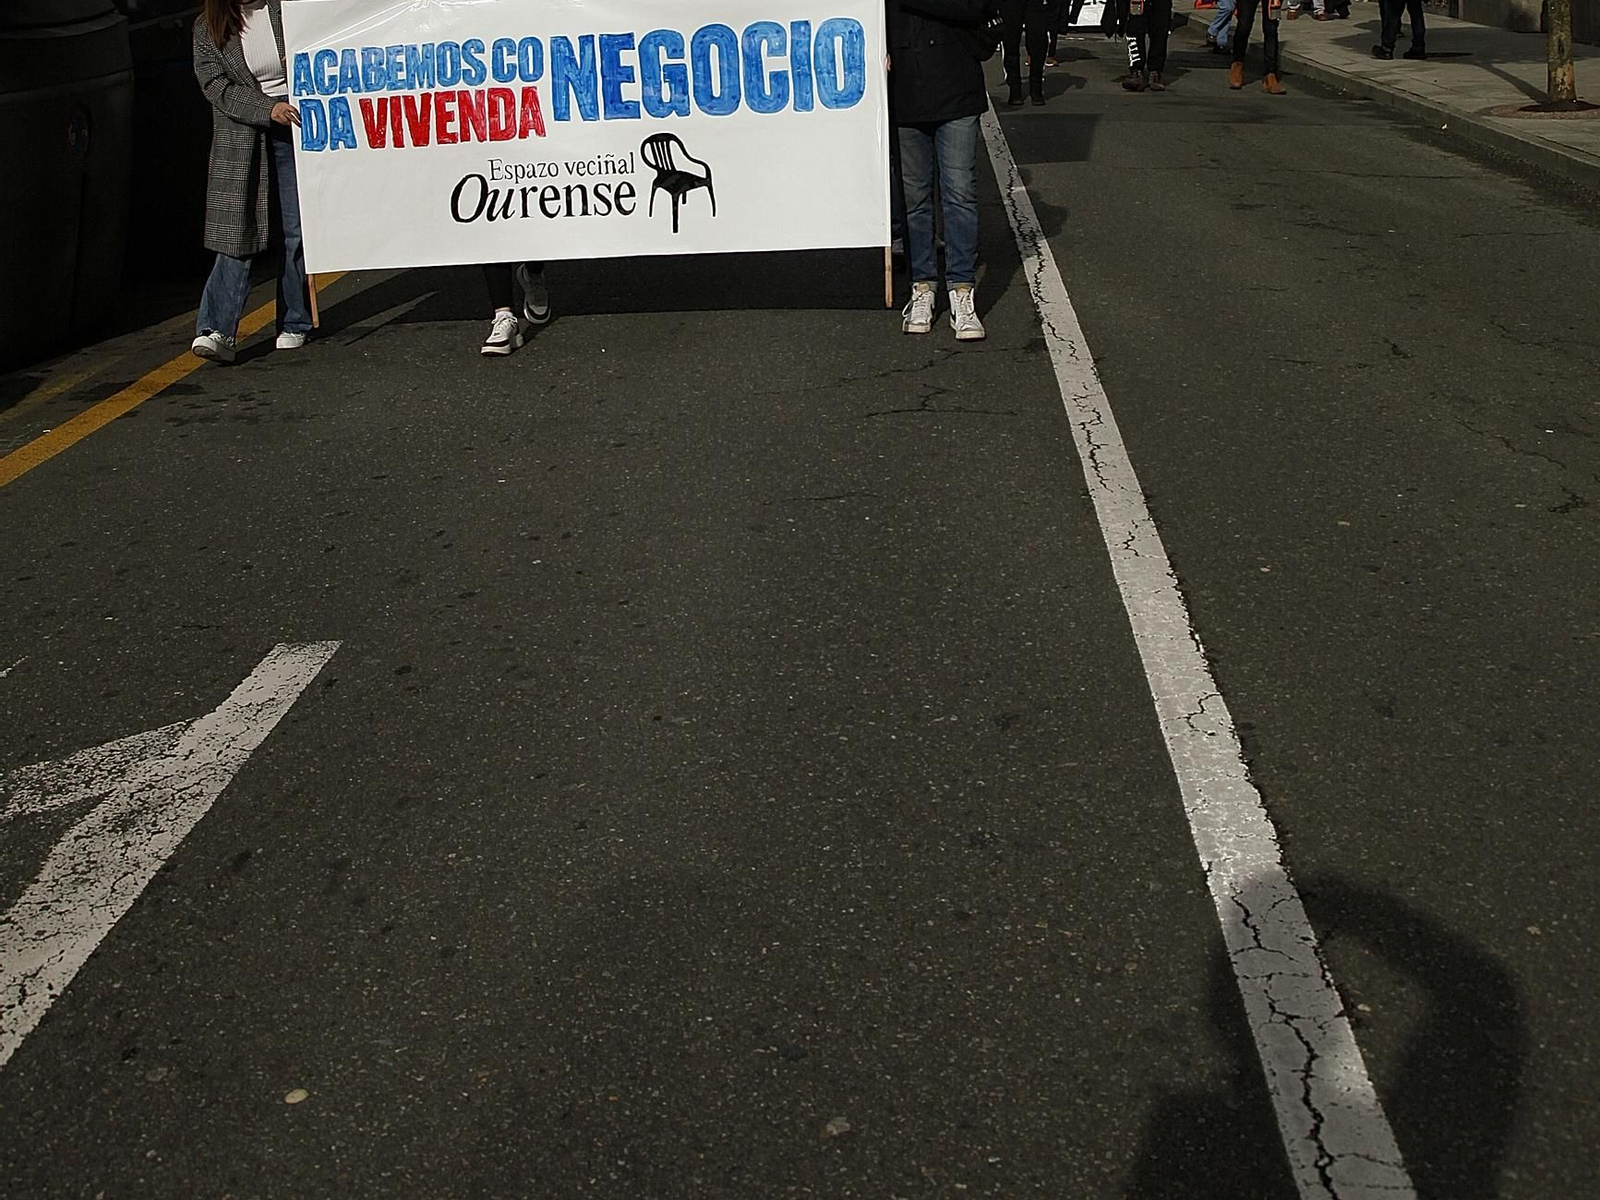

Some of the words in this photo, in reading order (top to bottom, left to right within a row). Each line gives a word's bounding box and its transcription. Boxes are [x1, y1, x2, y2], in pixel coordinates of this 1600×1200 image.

[292, 37, 487, 97] ACABEMOS
[491, 35, 545, 85] CO
[549, 16, 867, 122] NEGOCIO
[300, 94, 358, 152] DA
[360, 85, 547, 149] VIVENDA
[489, 157, 560, 184] Espazo
[563, 151, 636, 177] veciñal
[450, 172, 638, 224] Ourense
